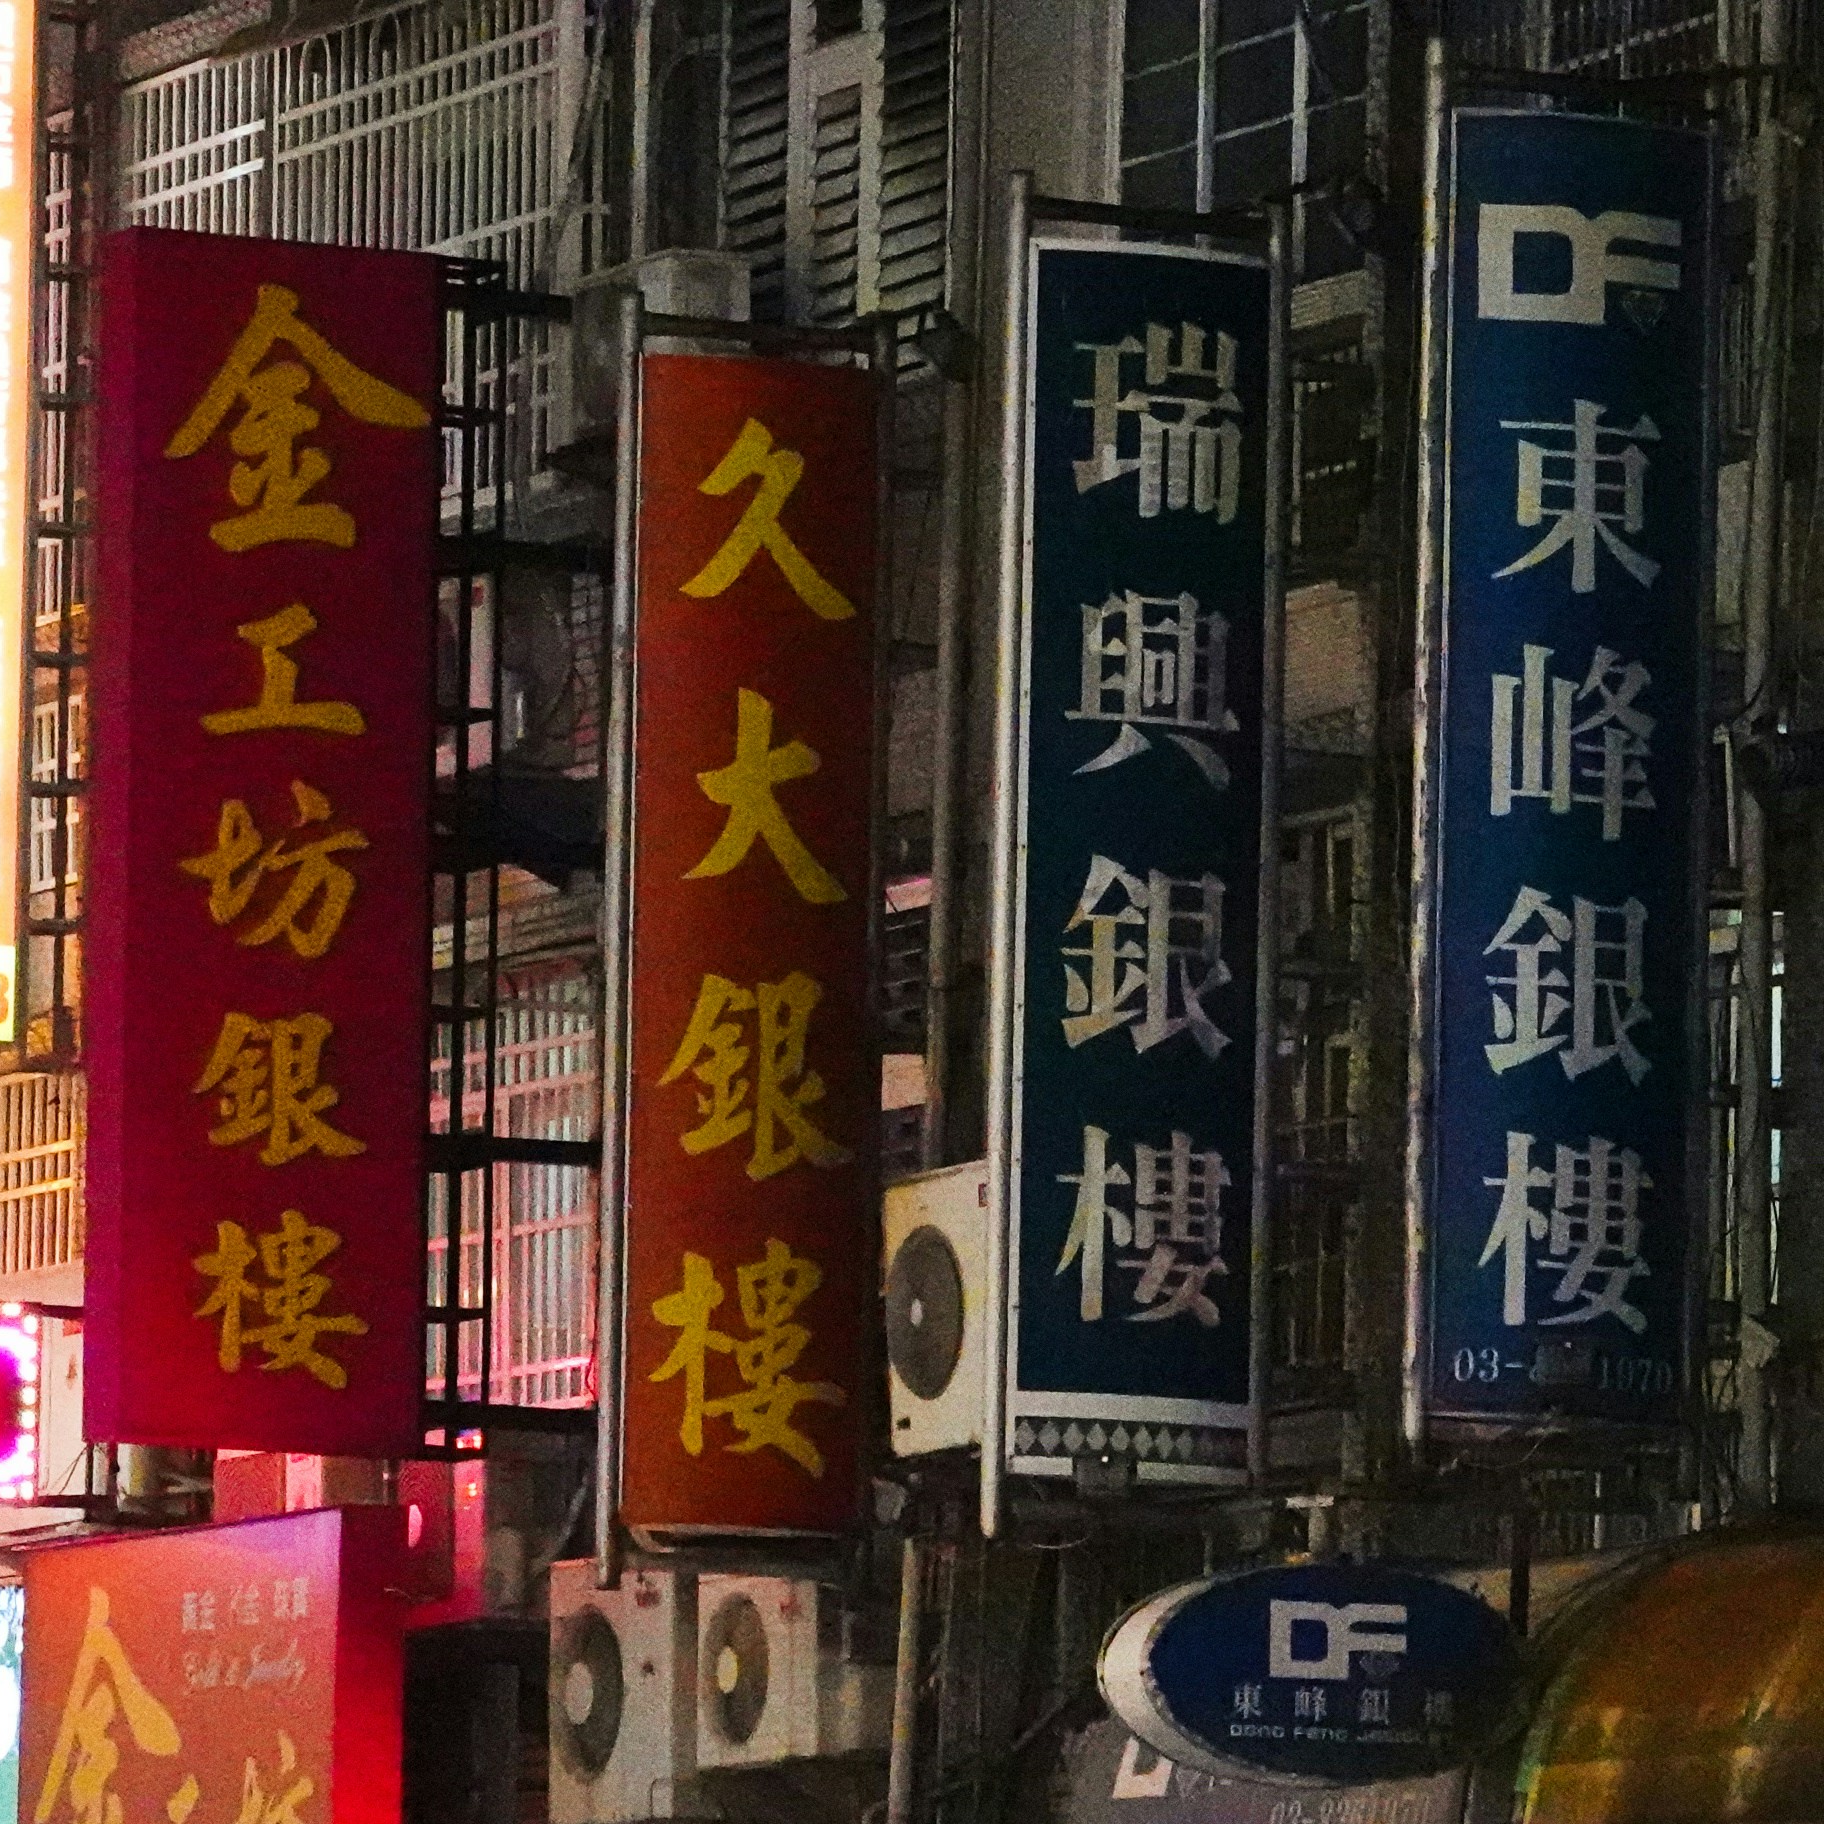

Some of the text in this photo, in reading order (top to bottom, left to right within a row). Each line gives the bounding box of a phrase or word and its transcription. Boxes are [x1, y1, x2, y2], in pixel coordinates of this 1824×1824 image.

[1476, 200, 1684, 322] DF
[162, 283, 432, 1391] 金工坊銀樓
[649, 416, 857, 1478] 久大銀樓
[1054, 319, 1241, 1328] 瑞興銀樓
[1476, 398, 1664, 1335] 東峰銀樓
[1270, 1599, 1407, 1680] DF
